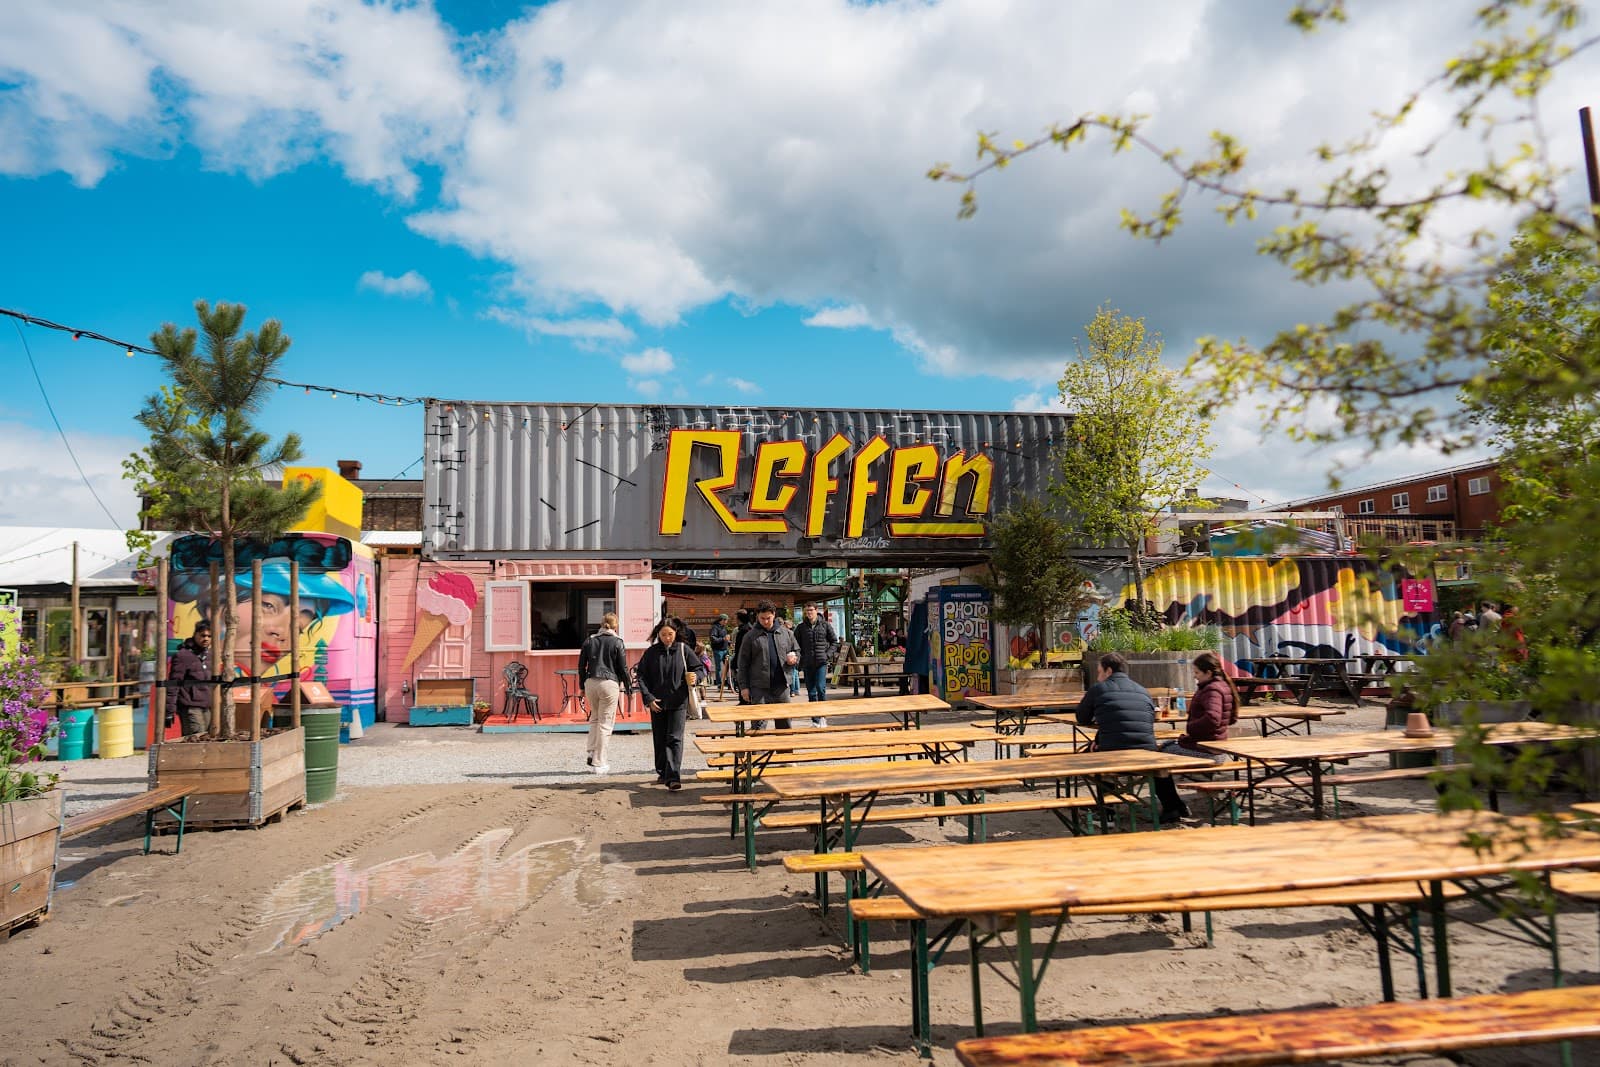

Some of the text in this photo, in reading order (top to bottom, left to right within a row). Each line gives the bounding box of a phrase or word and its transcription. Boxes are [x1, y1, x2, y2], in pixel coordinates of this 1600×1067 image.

[658, 429, 994, 538] Reffen
[944, 601, 989, 619] PHOTO
[945, 618, 989, 642] BOOTH
[945, 642, 990, 666] PHOTO
[946, 666, 991, 692] BOOTH
